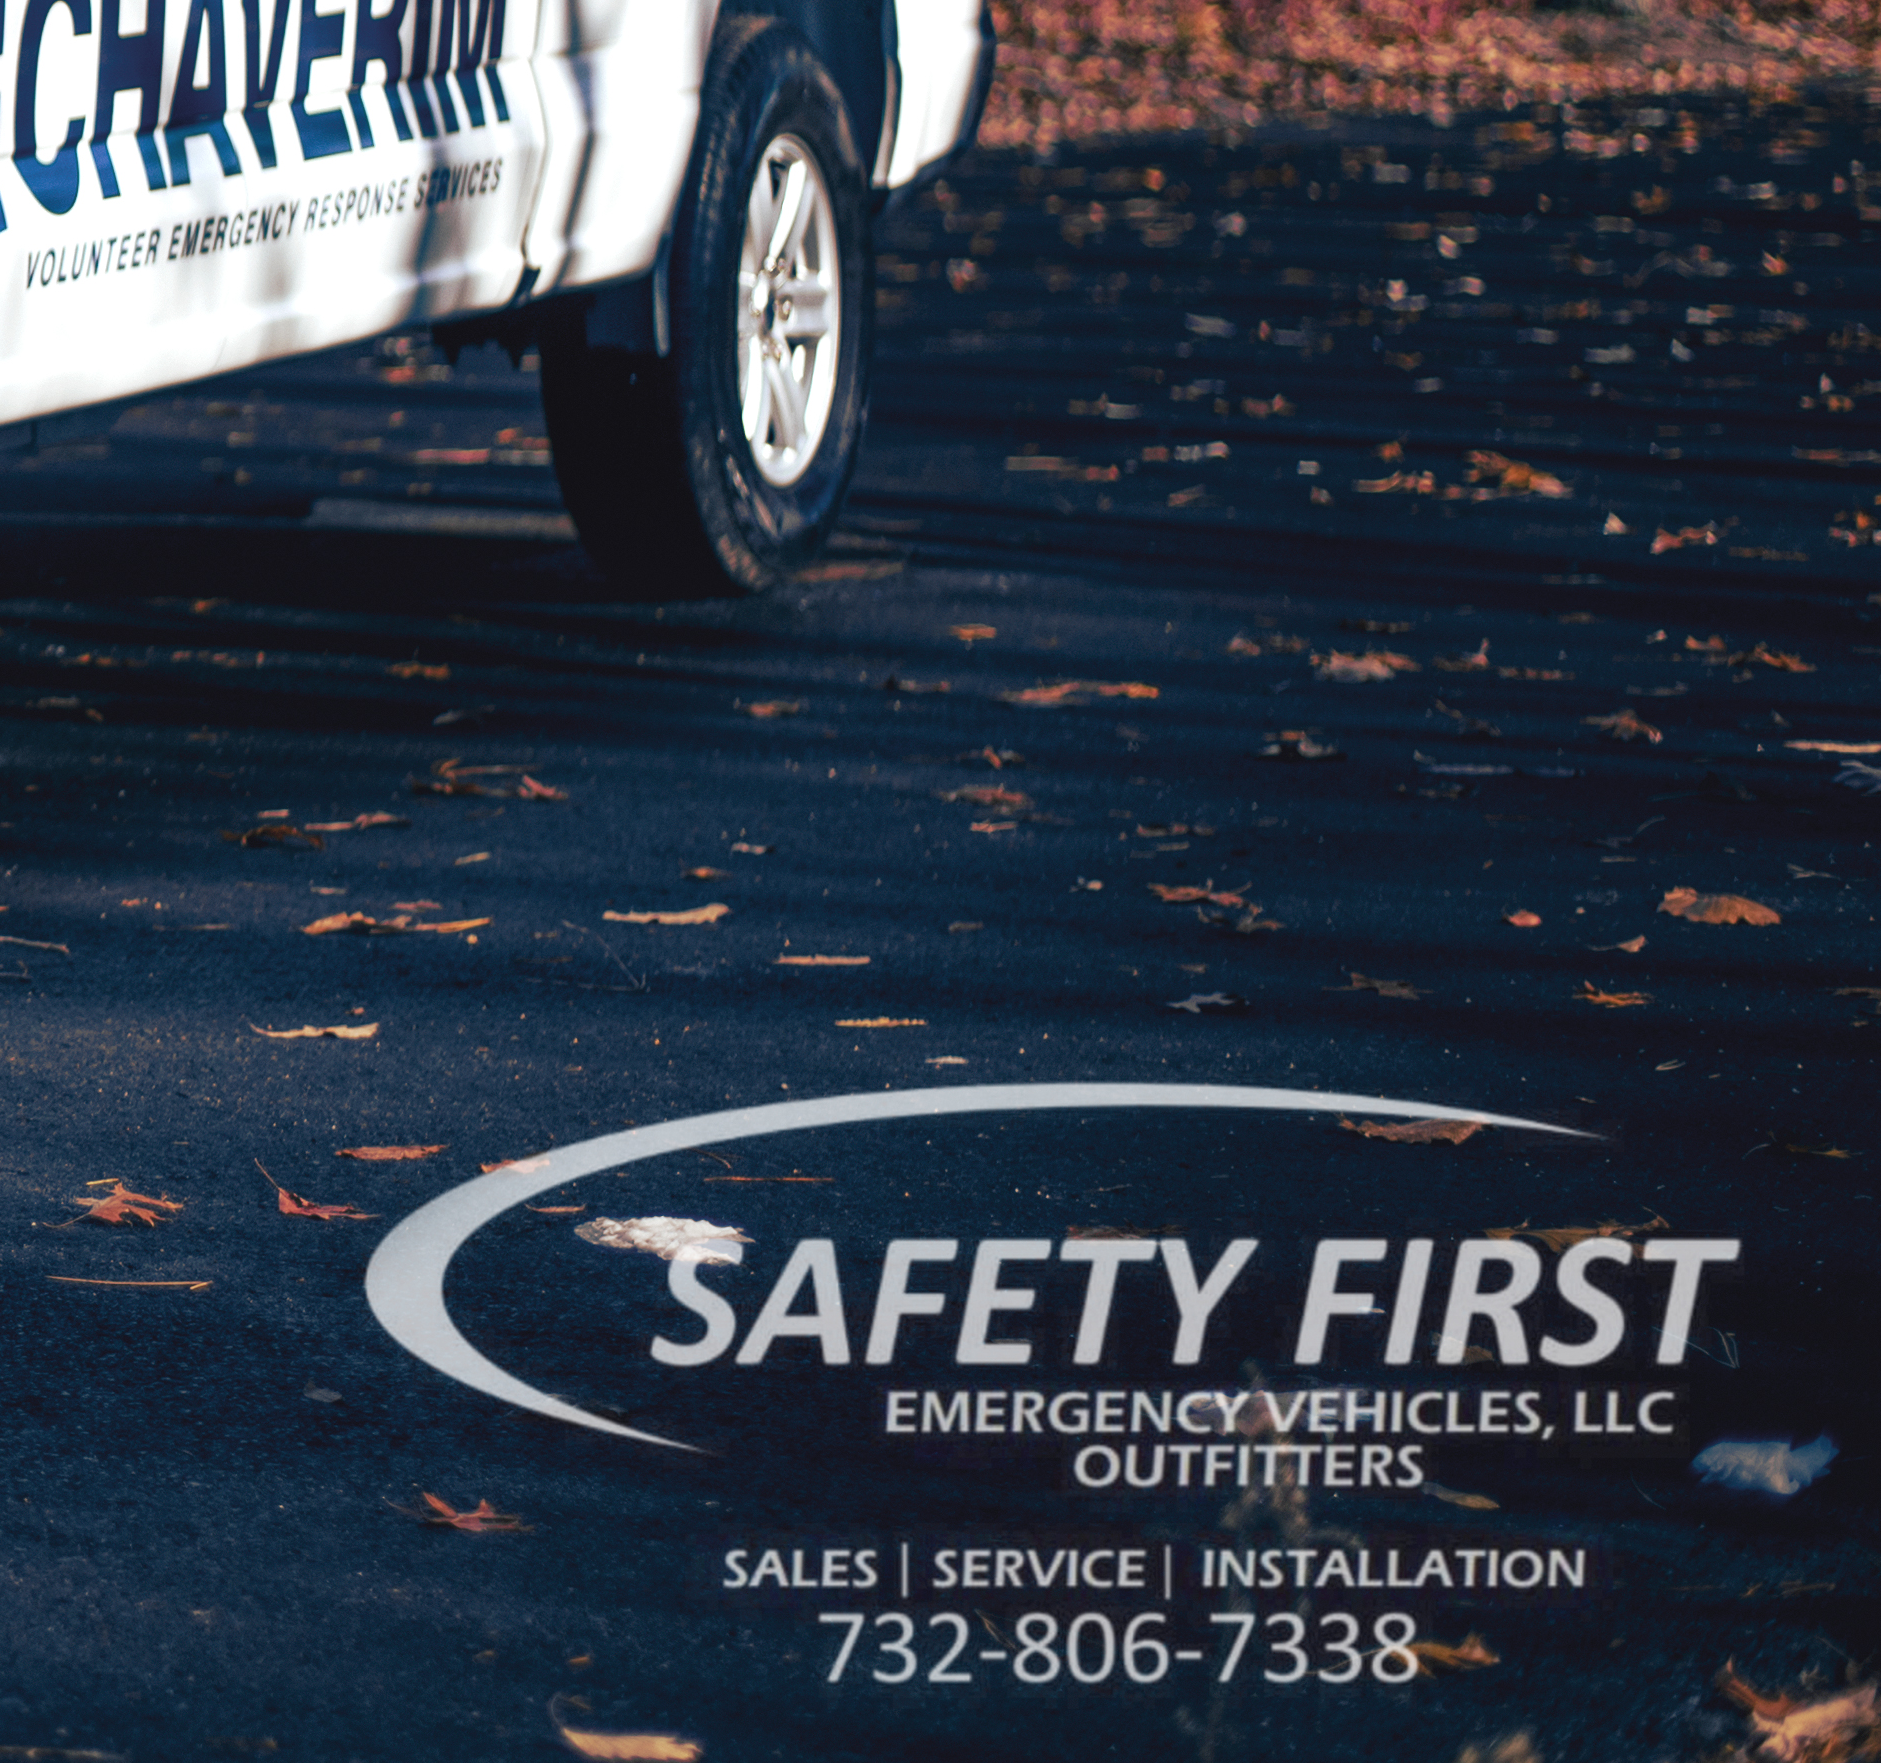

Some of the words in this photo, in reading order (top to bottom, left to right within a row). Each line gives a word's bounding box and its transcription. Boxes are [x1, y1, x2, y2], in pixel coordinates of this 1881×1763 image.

[25, 228, 161, 290] VOLUNTEER
[167, 199, 300, 262] EMERGENCY
[303, 177, 410, 231] RESPONSE
[413, 158, 504, 211] SERVICES
